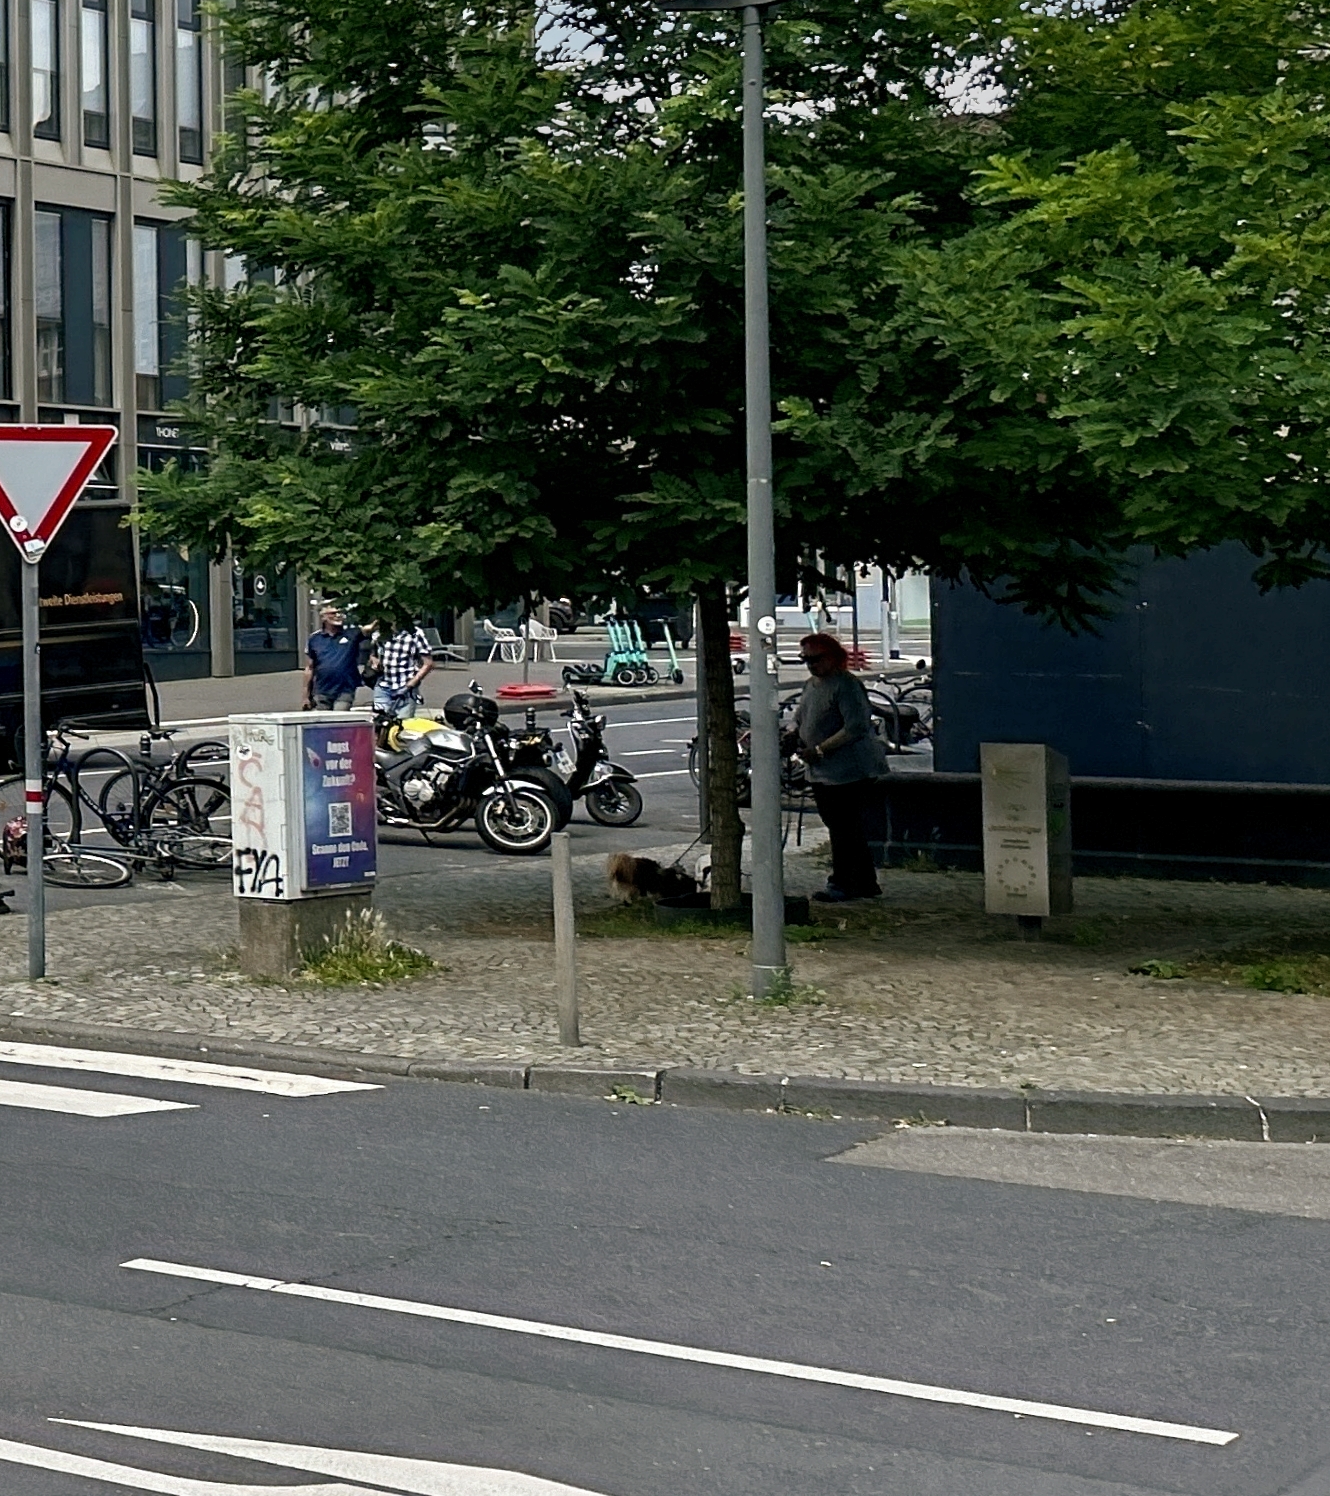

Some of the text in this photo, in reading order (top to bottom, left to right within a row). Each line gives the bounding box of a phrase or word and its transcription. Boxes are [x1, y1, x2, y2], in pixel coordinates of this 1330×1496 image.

[64, 592, 123, 605] Dienstleistungen
[325, 757, 353, 770] vor der
